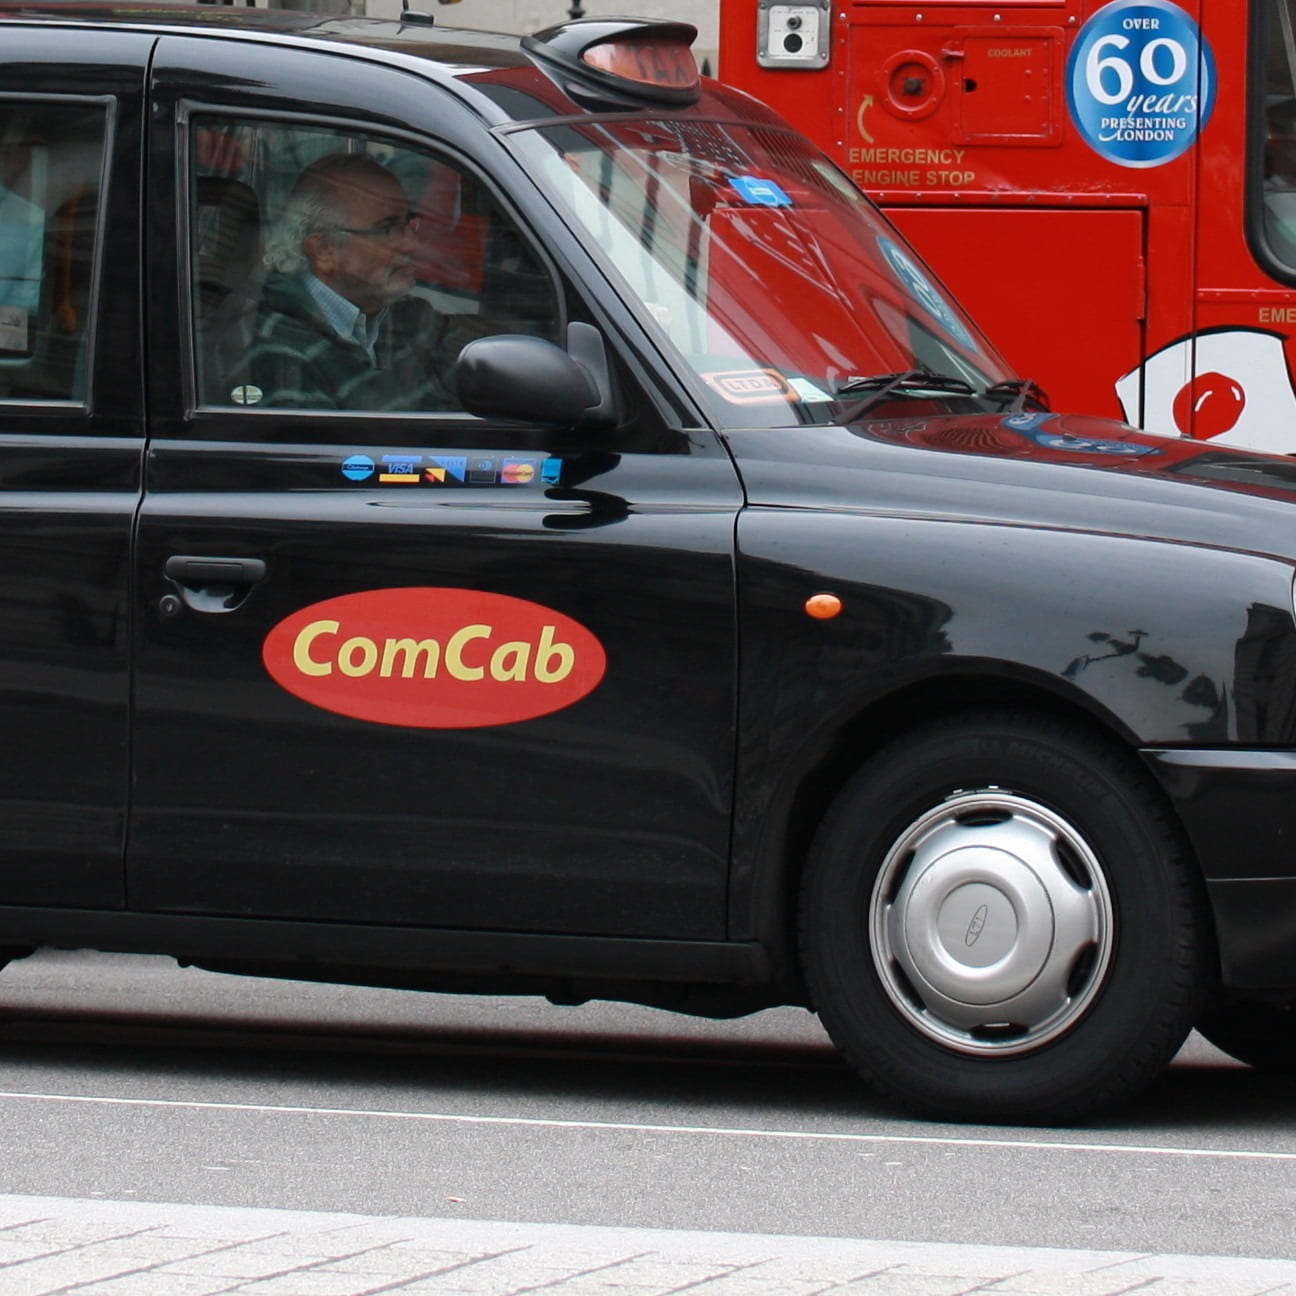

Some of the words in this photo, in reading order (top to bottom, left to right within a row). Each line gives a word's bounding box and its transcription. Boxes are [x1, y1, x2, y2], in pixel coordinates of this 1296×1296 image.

[1122, 17, 1161, 31] OVER
[987, 48, 1032, 57] COOLANT
[1086, 33, 1187, 106] 60
[1120, 93, 1198, 125] years
[1100, 117, 1187, 129] PRESENTING
[1117, 129, 1175, 142] LONDON
[848, 147, 965, 166] EMERGENCY
[852, 168, 921, 186] ENGINE
[926, 170, 976, 187] STOP
[388, 463, 414, 474] VISA
[292, 619, 575, 684] ComCab
